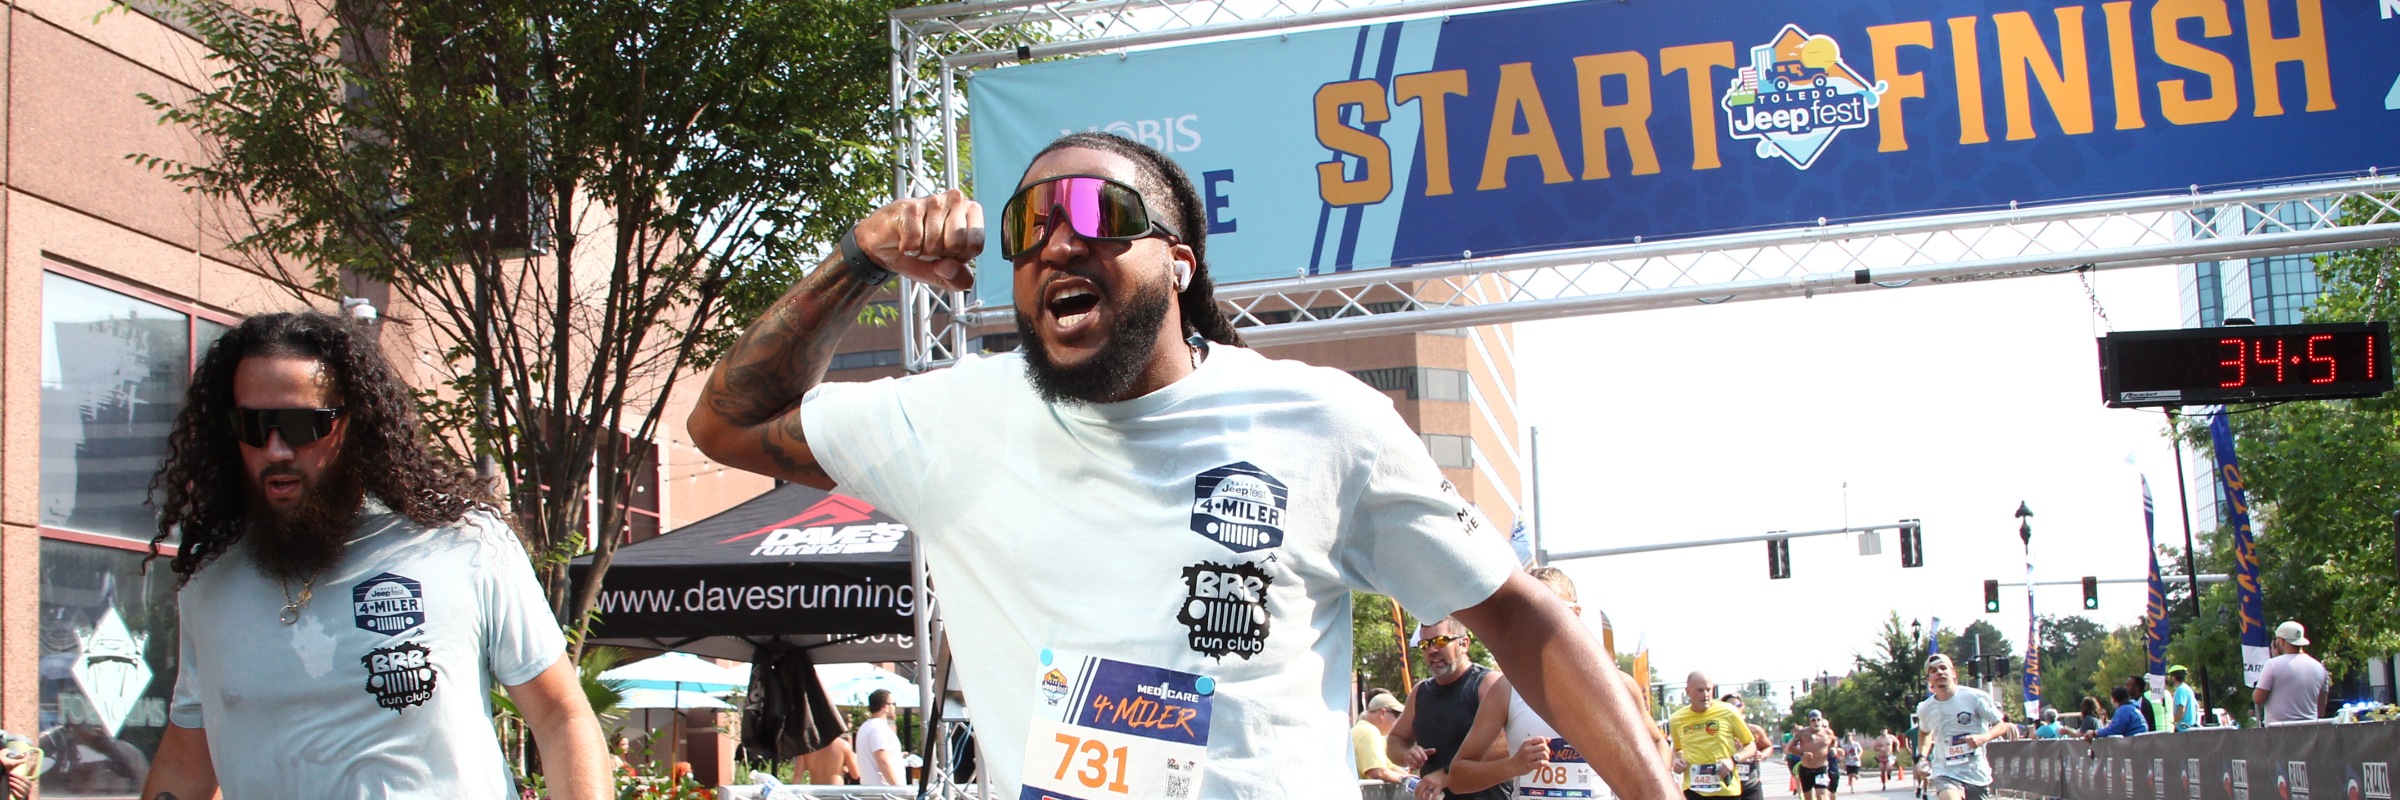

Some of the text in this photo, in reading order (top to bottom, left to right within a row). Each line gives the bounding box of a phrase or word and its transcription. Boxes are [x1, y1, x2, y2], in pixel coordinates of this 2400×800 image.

[1866, 0, 2337, 153] FINISH
[1757, 88, 1835, 104] TOLEDO
[1314, 41, 1735, 207] START
[761, 522, 909, 546] DAVE'S
[1195, 570, 1264, 603] BRB
[1194, 636, 1263, 652] run club
[371, 649, 425, 674] BRB
[381, 691, 431, 706] run club
[1054, 732, 1129, 794] 731
[1532, 766, 1568, 785] 708
[1694, 776, 1711, 784] 442
